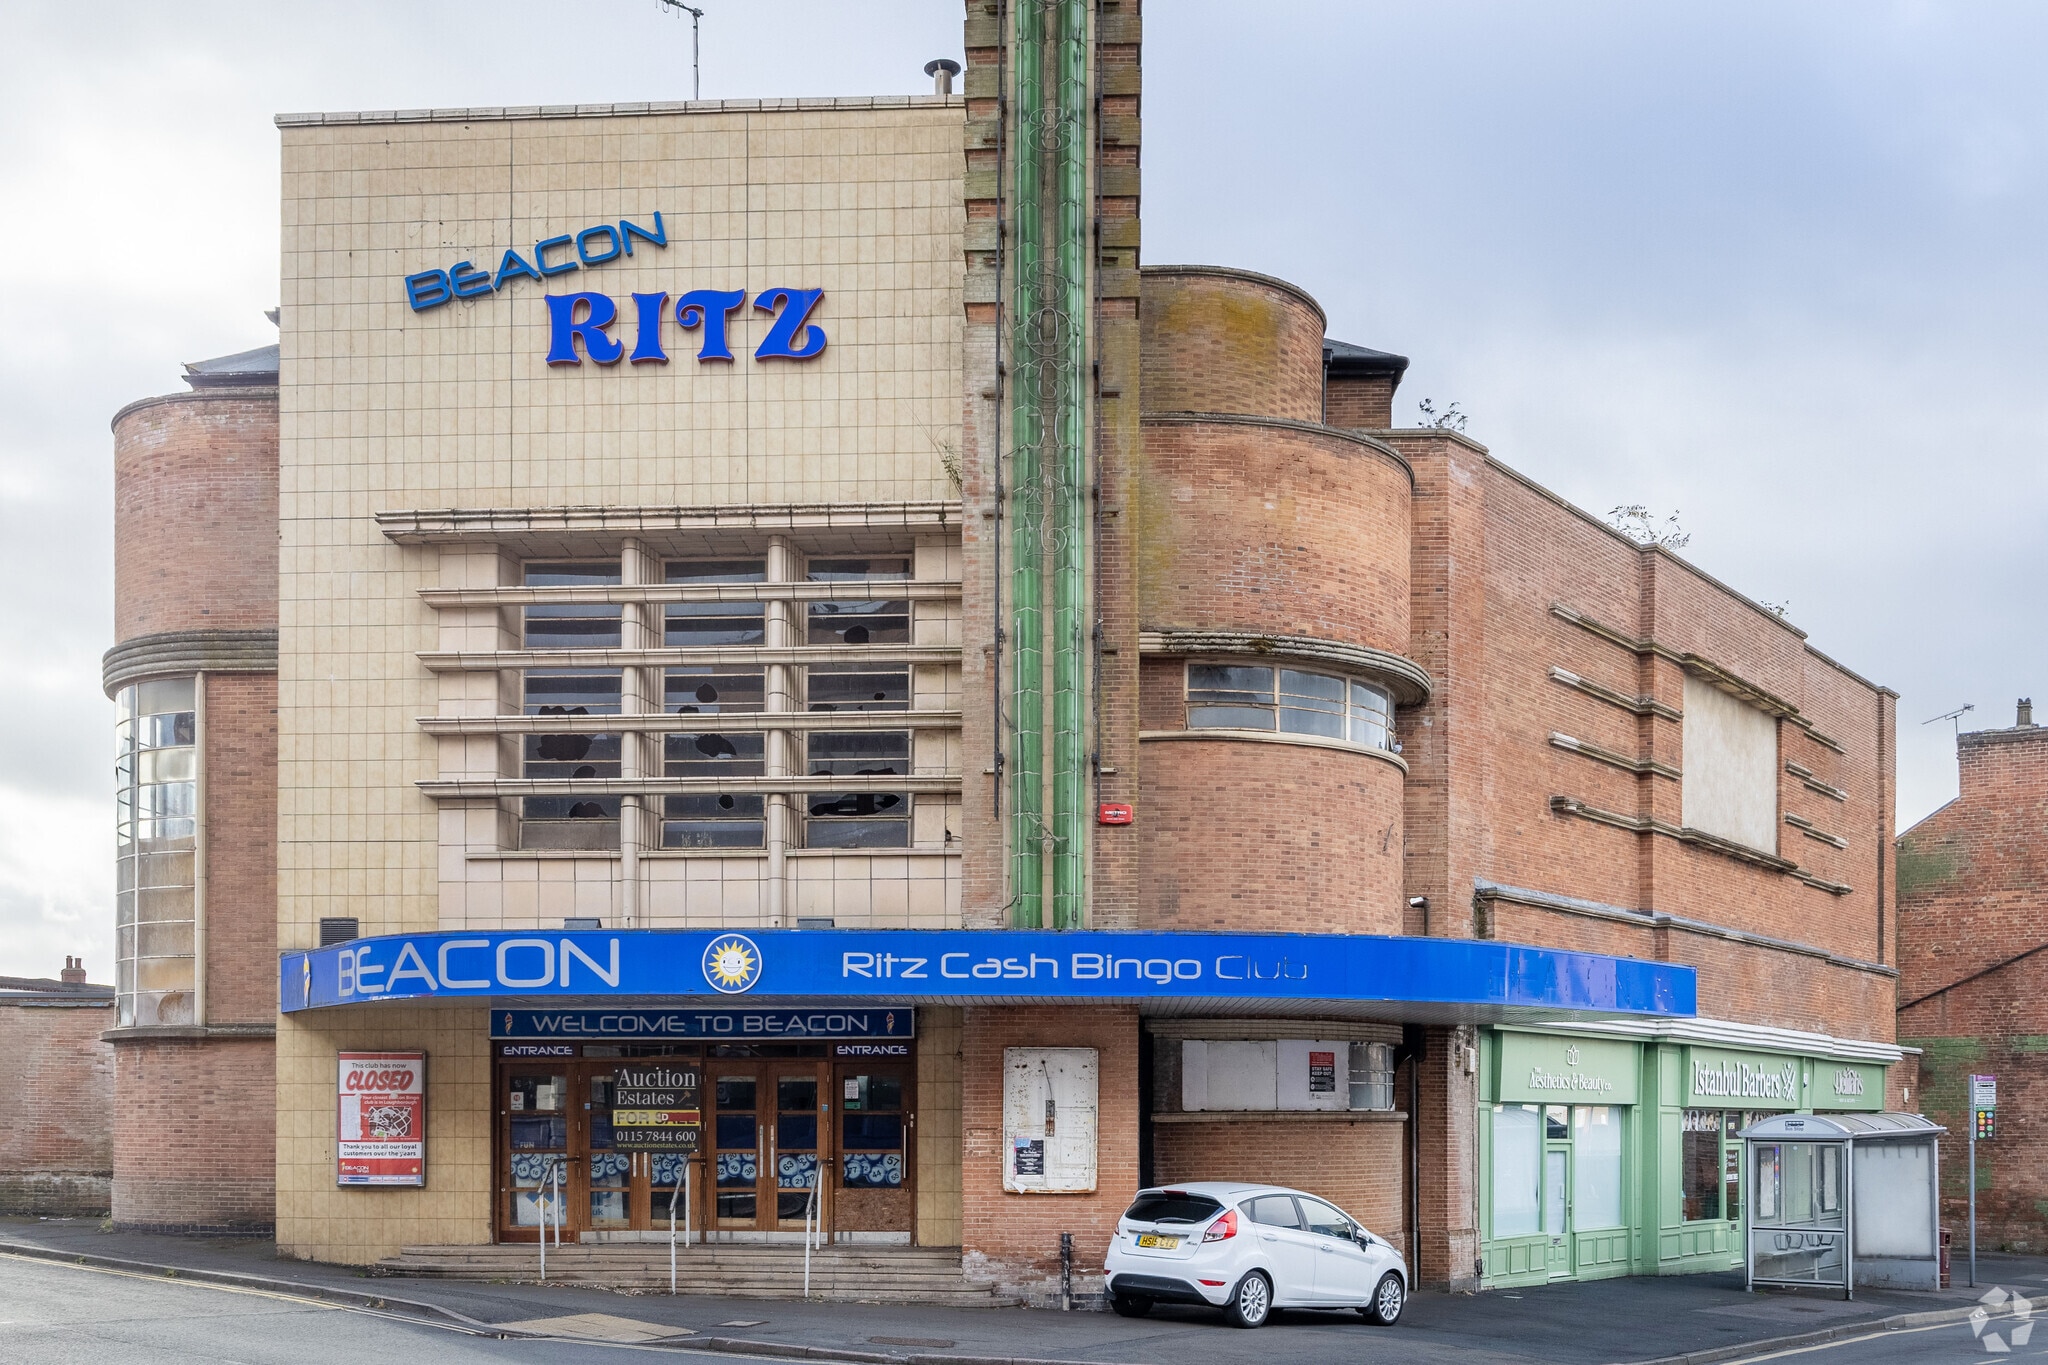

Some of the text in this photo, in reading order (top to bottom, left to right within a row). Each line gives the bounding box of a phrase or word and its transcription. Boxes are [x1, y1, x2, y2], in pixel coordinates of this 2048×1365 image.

[404, 210, 668, 313] BEACON
[543, 287, 828, 368] RITZ
[1024, 256, 1074, 557] SOCIAL
[338, 938, 620, 997] BEACON
[842, 952, 1308, 985] Ritz Cash Bingo Club
[531, 1014, 869, 1033] WELCOME TO BEACON
[503, 1045, 574, 1056] ENTRANCE
[836, 1045, 908, 1055] ENTRANCE
[346, 1070, 415, 1092] CLOSED
[617, 1068, 697, 1088] Auction
[1528, 1072, 1570, 1090] Aesthetics
[1570, 1073, 1578, 1090] &
[1578, 1074, 1604, 1096] Beauty
[1694, 1060, 1781, 1099] Istanbul Barbers
[617, 1090, 675, 1106] Estates
[616, 1111, 650, 1125] FOR
[616, 1130, 696, 1142] 0115 7844 600
[401, 1143, 417, 1152] loyal
[519, 1141, 535, 1149] FUN
[783, 1160, 794, 1171] 63
[886, 1155, 900, 1166] 57
[744, 1166, 755, 1176] 38
[872, 1170, 882, 1178] 44
